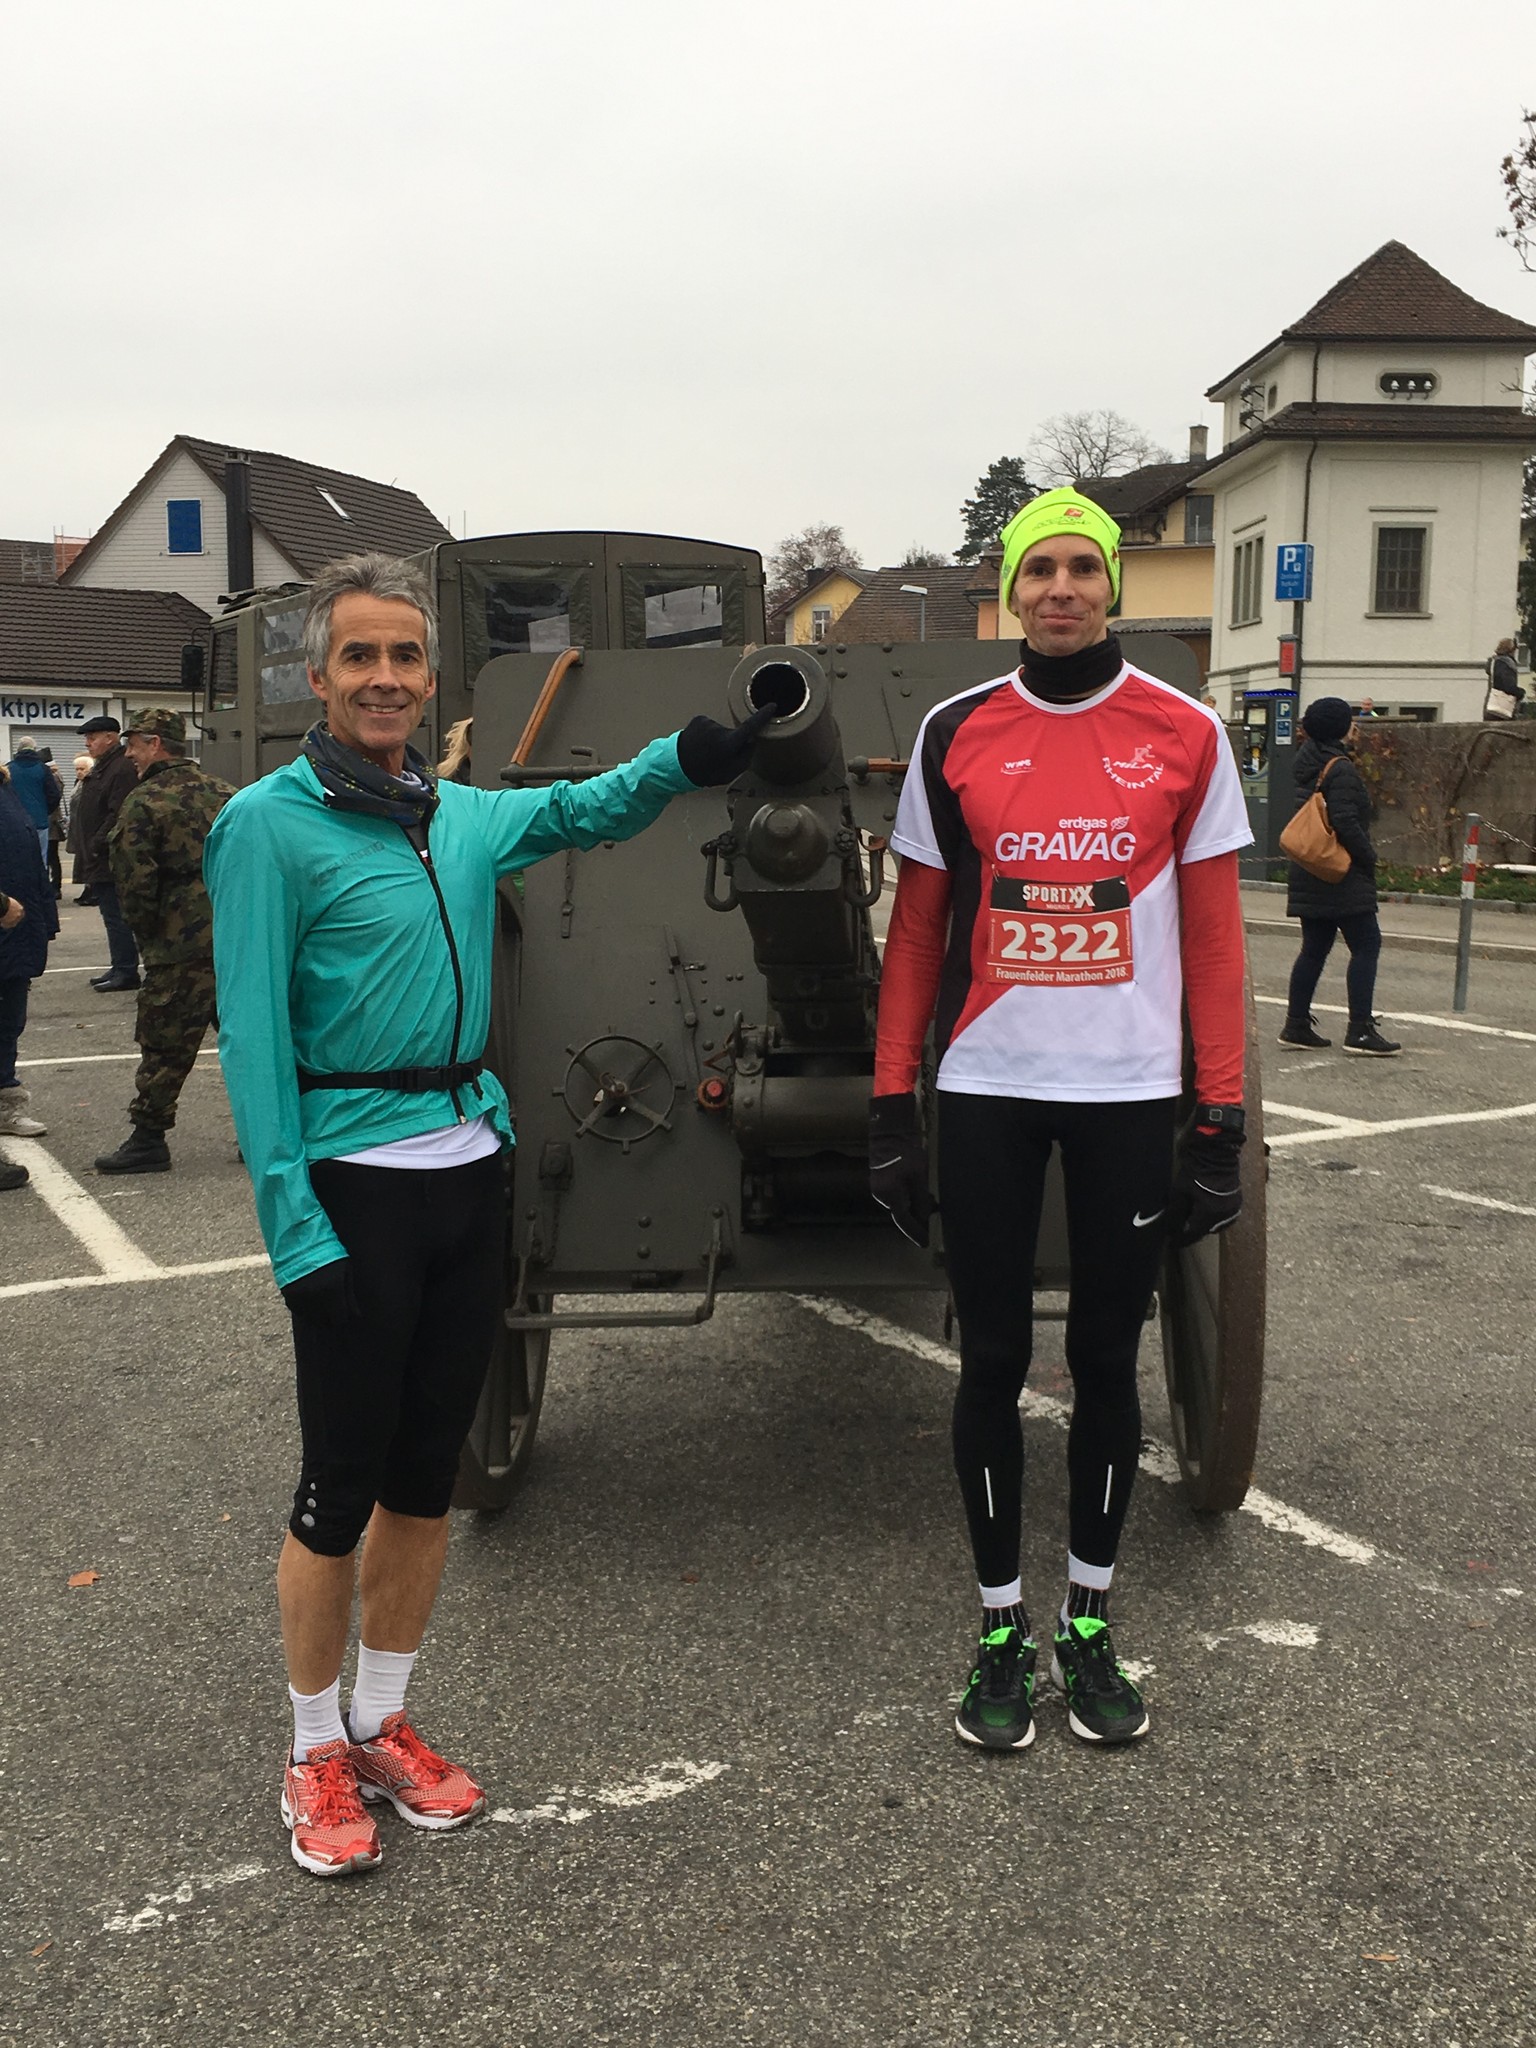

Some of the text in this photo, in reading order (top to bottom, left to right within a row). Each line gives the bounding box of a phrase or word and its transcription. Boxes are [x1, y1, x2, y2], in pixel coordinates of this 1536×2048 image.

[1283, 547, 1296, 571] P
[1, 697, 85, 723] ktplatz
[1280, 703, 1290, 716] P
[1102, 757, 1164, 789] RHEINTAL
[1058, 816, 1107, 831] erdgas
[995, 831, 1137, 862] GRAVAG
[1000, 920, 1120, 962] 2322
[996, 967, 1126, 982] Frauenfelder Marathon 2018
